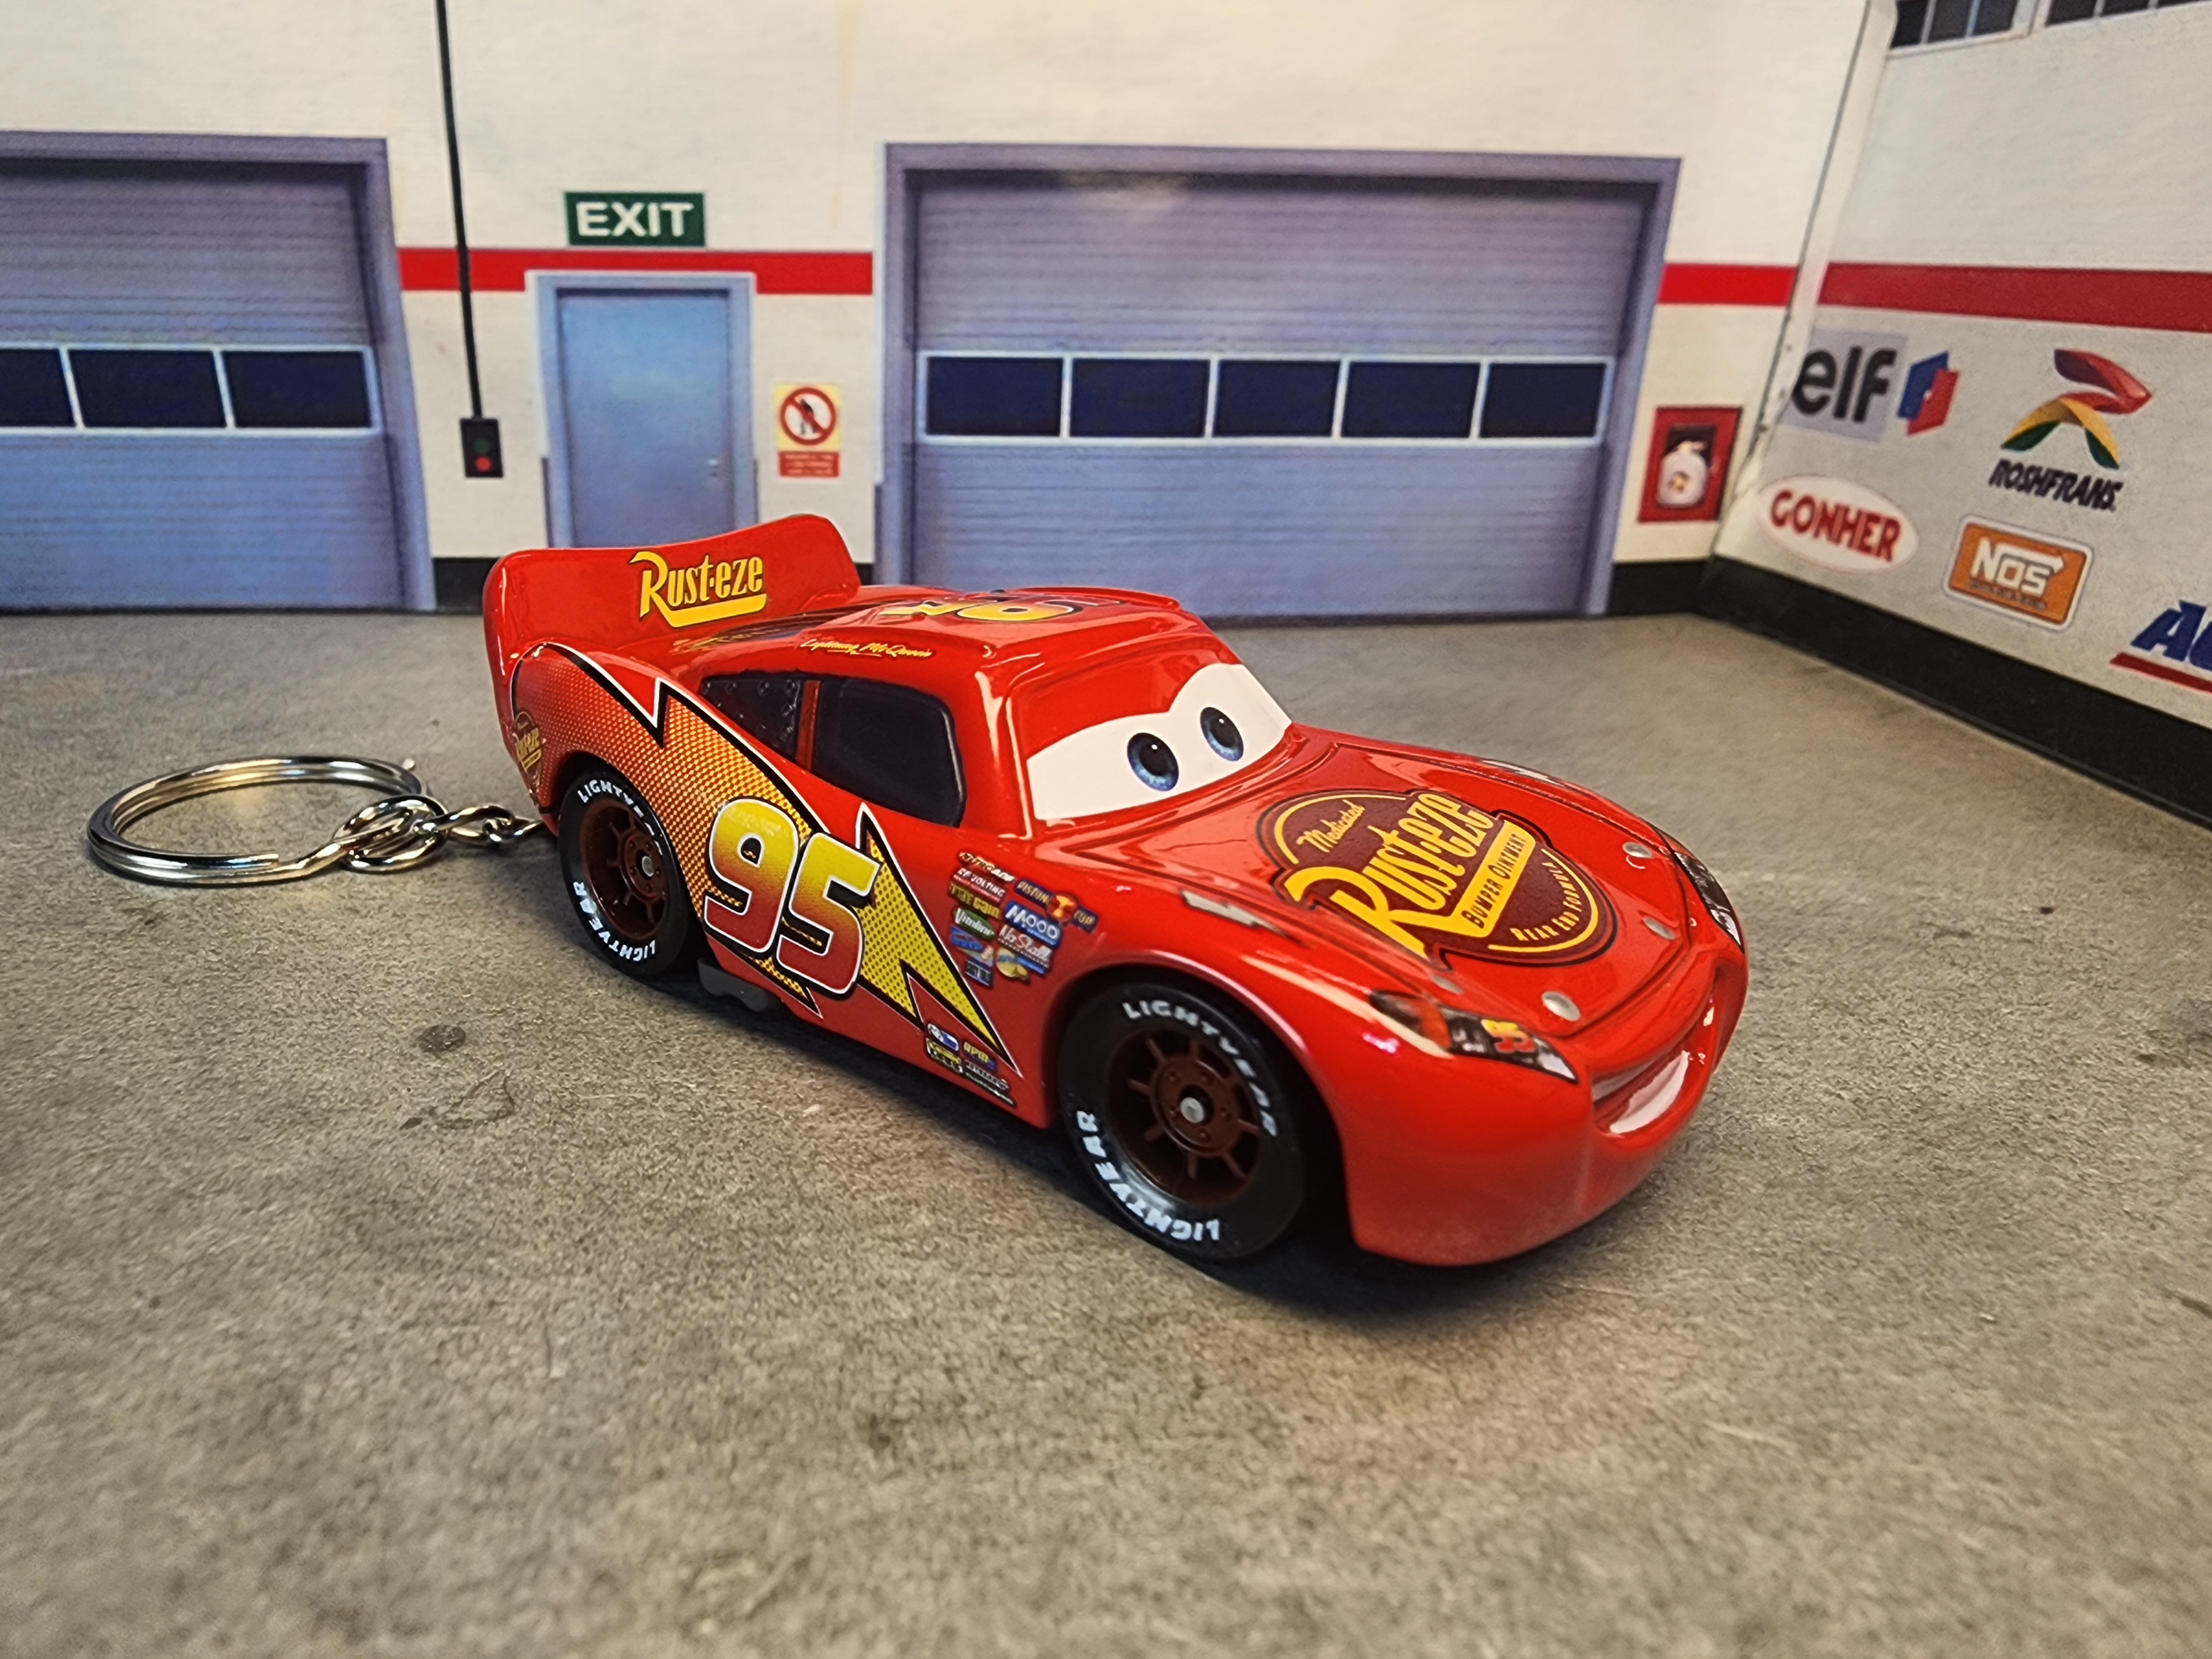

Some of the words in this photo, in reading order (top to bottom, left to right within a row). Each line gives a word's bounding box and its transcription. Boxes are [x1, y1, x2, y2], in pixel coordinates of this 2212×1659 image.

[576, 201, 694, 237] EXIT
[1791, 345, 1897, 423] elf
[1989, 459, 2123, 510] ROSHFRANS
[1771, 490, 1901, 562] GONHER
[1970, 536, 2064, 596] NOS
[1297, 800, 1365, 852] Medicated
[704, 798, 881, 994] 95
[1461, 878, 1504, 929] BUMPER
[1005, 905, 1061, 939] MOOD
[1510, 925, 1559, 942] REAR
[1551, 911, 1580, 931] END
